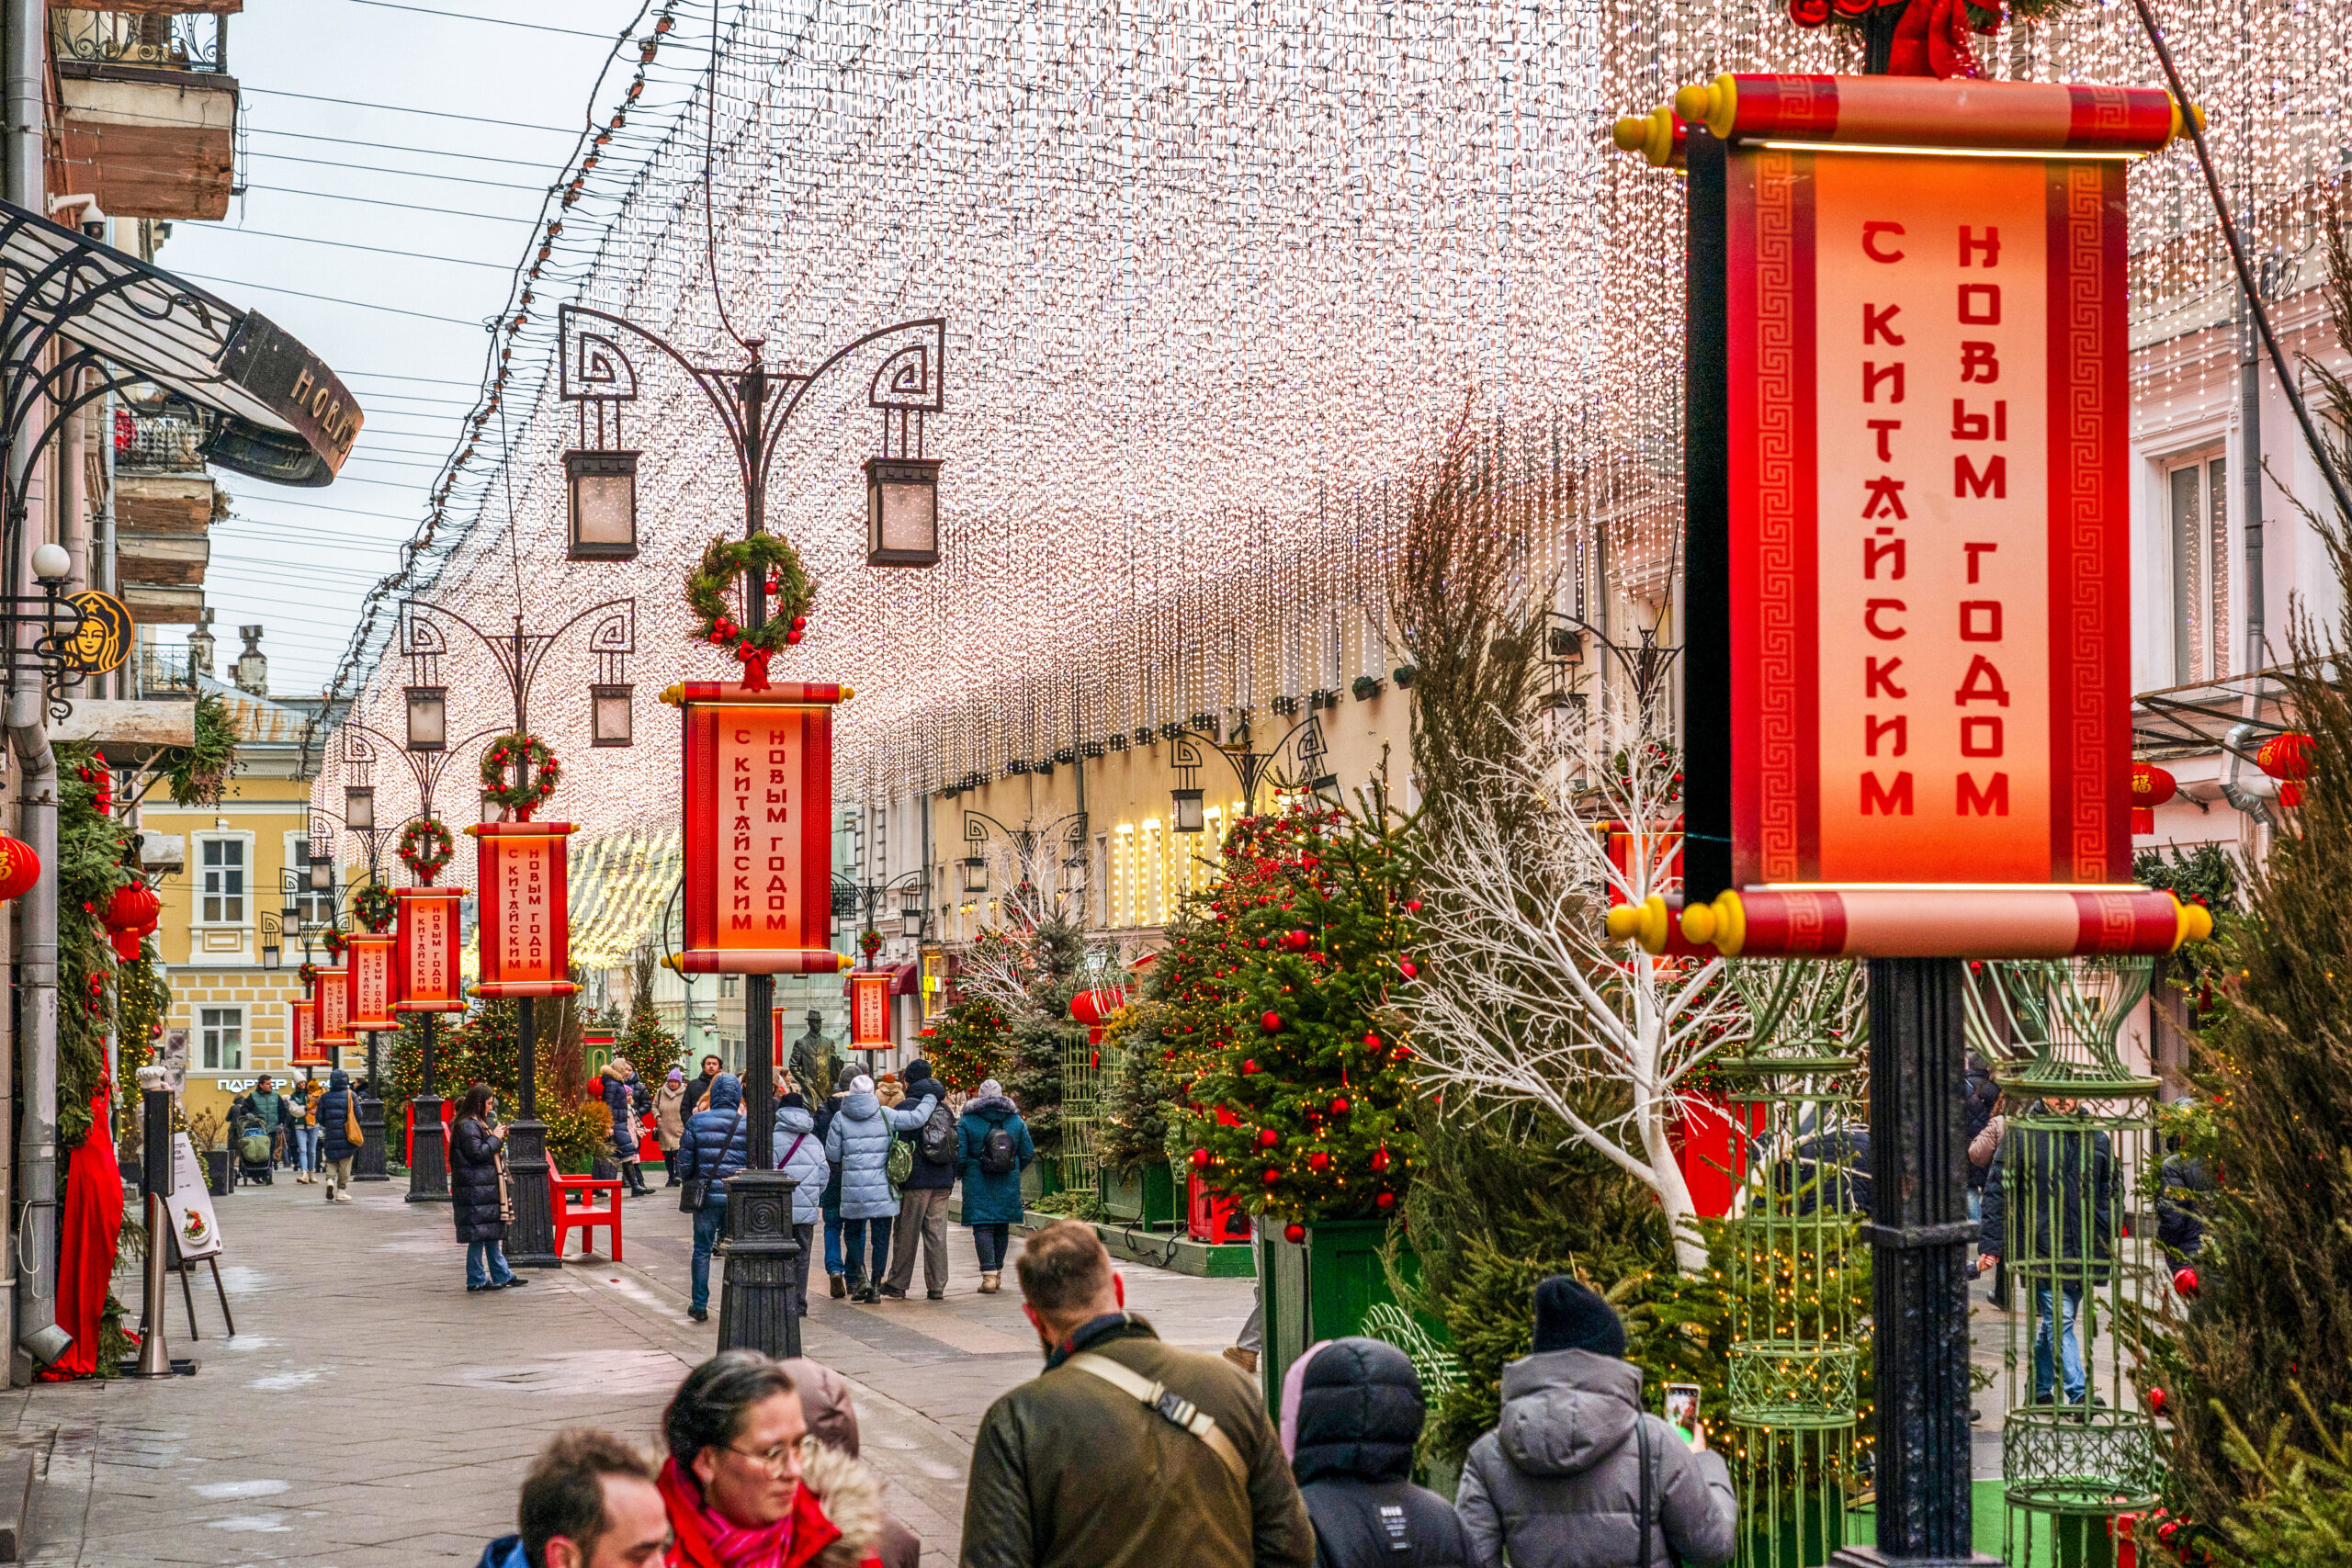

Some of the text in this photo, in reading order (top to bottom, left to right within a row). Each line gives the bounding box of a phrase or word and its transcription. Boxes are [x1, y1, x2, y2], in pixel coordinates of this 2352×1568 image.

[1860, 220, 1914, 817] С КИТАЙСКИМ
[1951, 224, 2010, 818] НОВЫМ ГОДОМ
[732, 728, 752, 931] С КИТАЙСКИМ
[766, 729, 787, 931] НОВЫМ ГОДОМ
[416, 918, 426, 993] КИТАЙСКИМ
[432, 906, 442, 993] НОВЫМ ГОДОМ
[507, 848, 521, 969] С КИТАЙСКИМ
[527, 849, 542, 969] НОВЫМ ГОДОМ
[362, 957, 370, 1016] КИТАЙСКИМ
[374, 948, 382, 1016] НОВЫМ ГОДОМ
[217, 1078, 288, 1093] ПАРЕР
